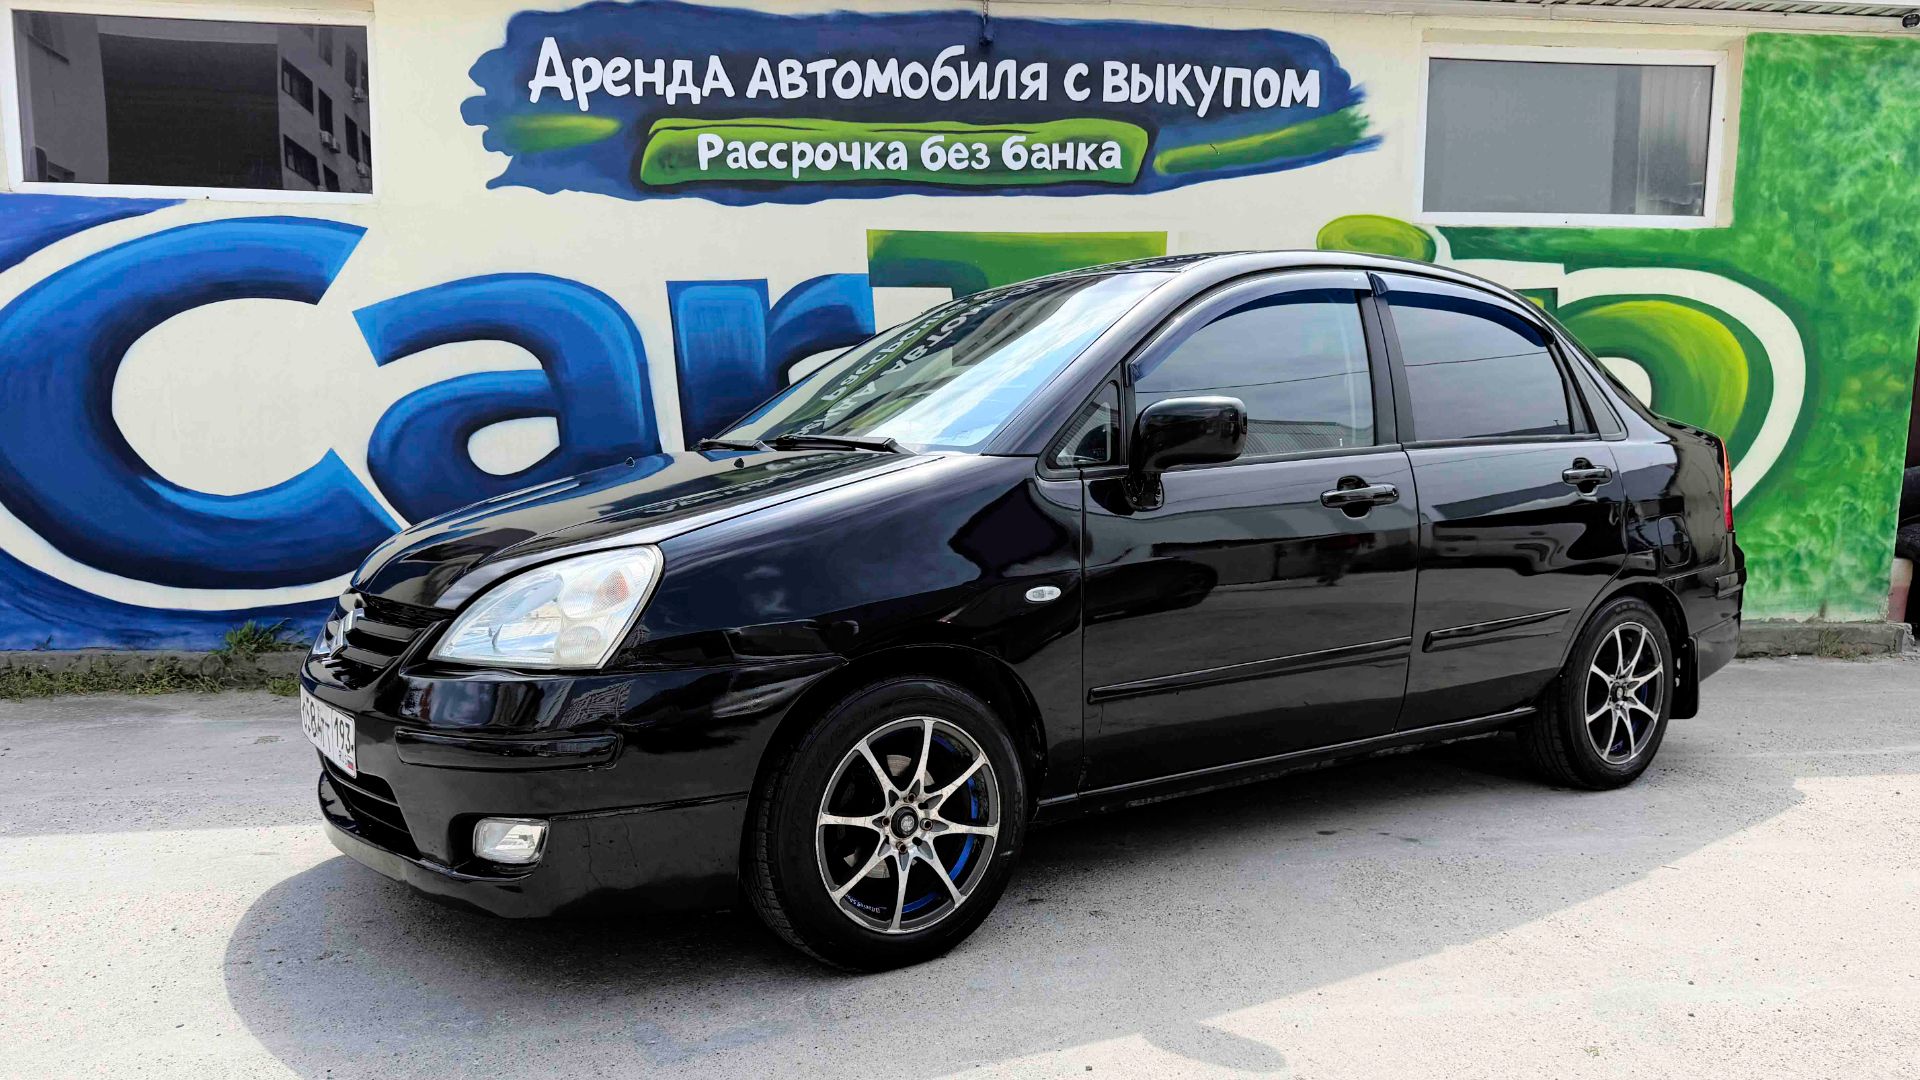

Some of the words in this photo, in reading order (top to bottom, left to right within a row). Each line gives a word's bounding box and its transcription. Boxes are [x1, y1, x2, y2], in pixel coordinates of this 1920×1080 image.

[1063, 62, 1092, 102] с
[1102, 60, 1320, 118] выкупом
[697, 133, 908, 179] Рассрочка
[920, 135, 992, 172] без
[1001, 135, 1123, 171] банка
[334, 716, 351, 754] 193
